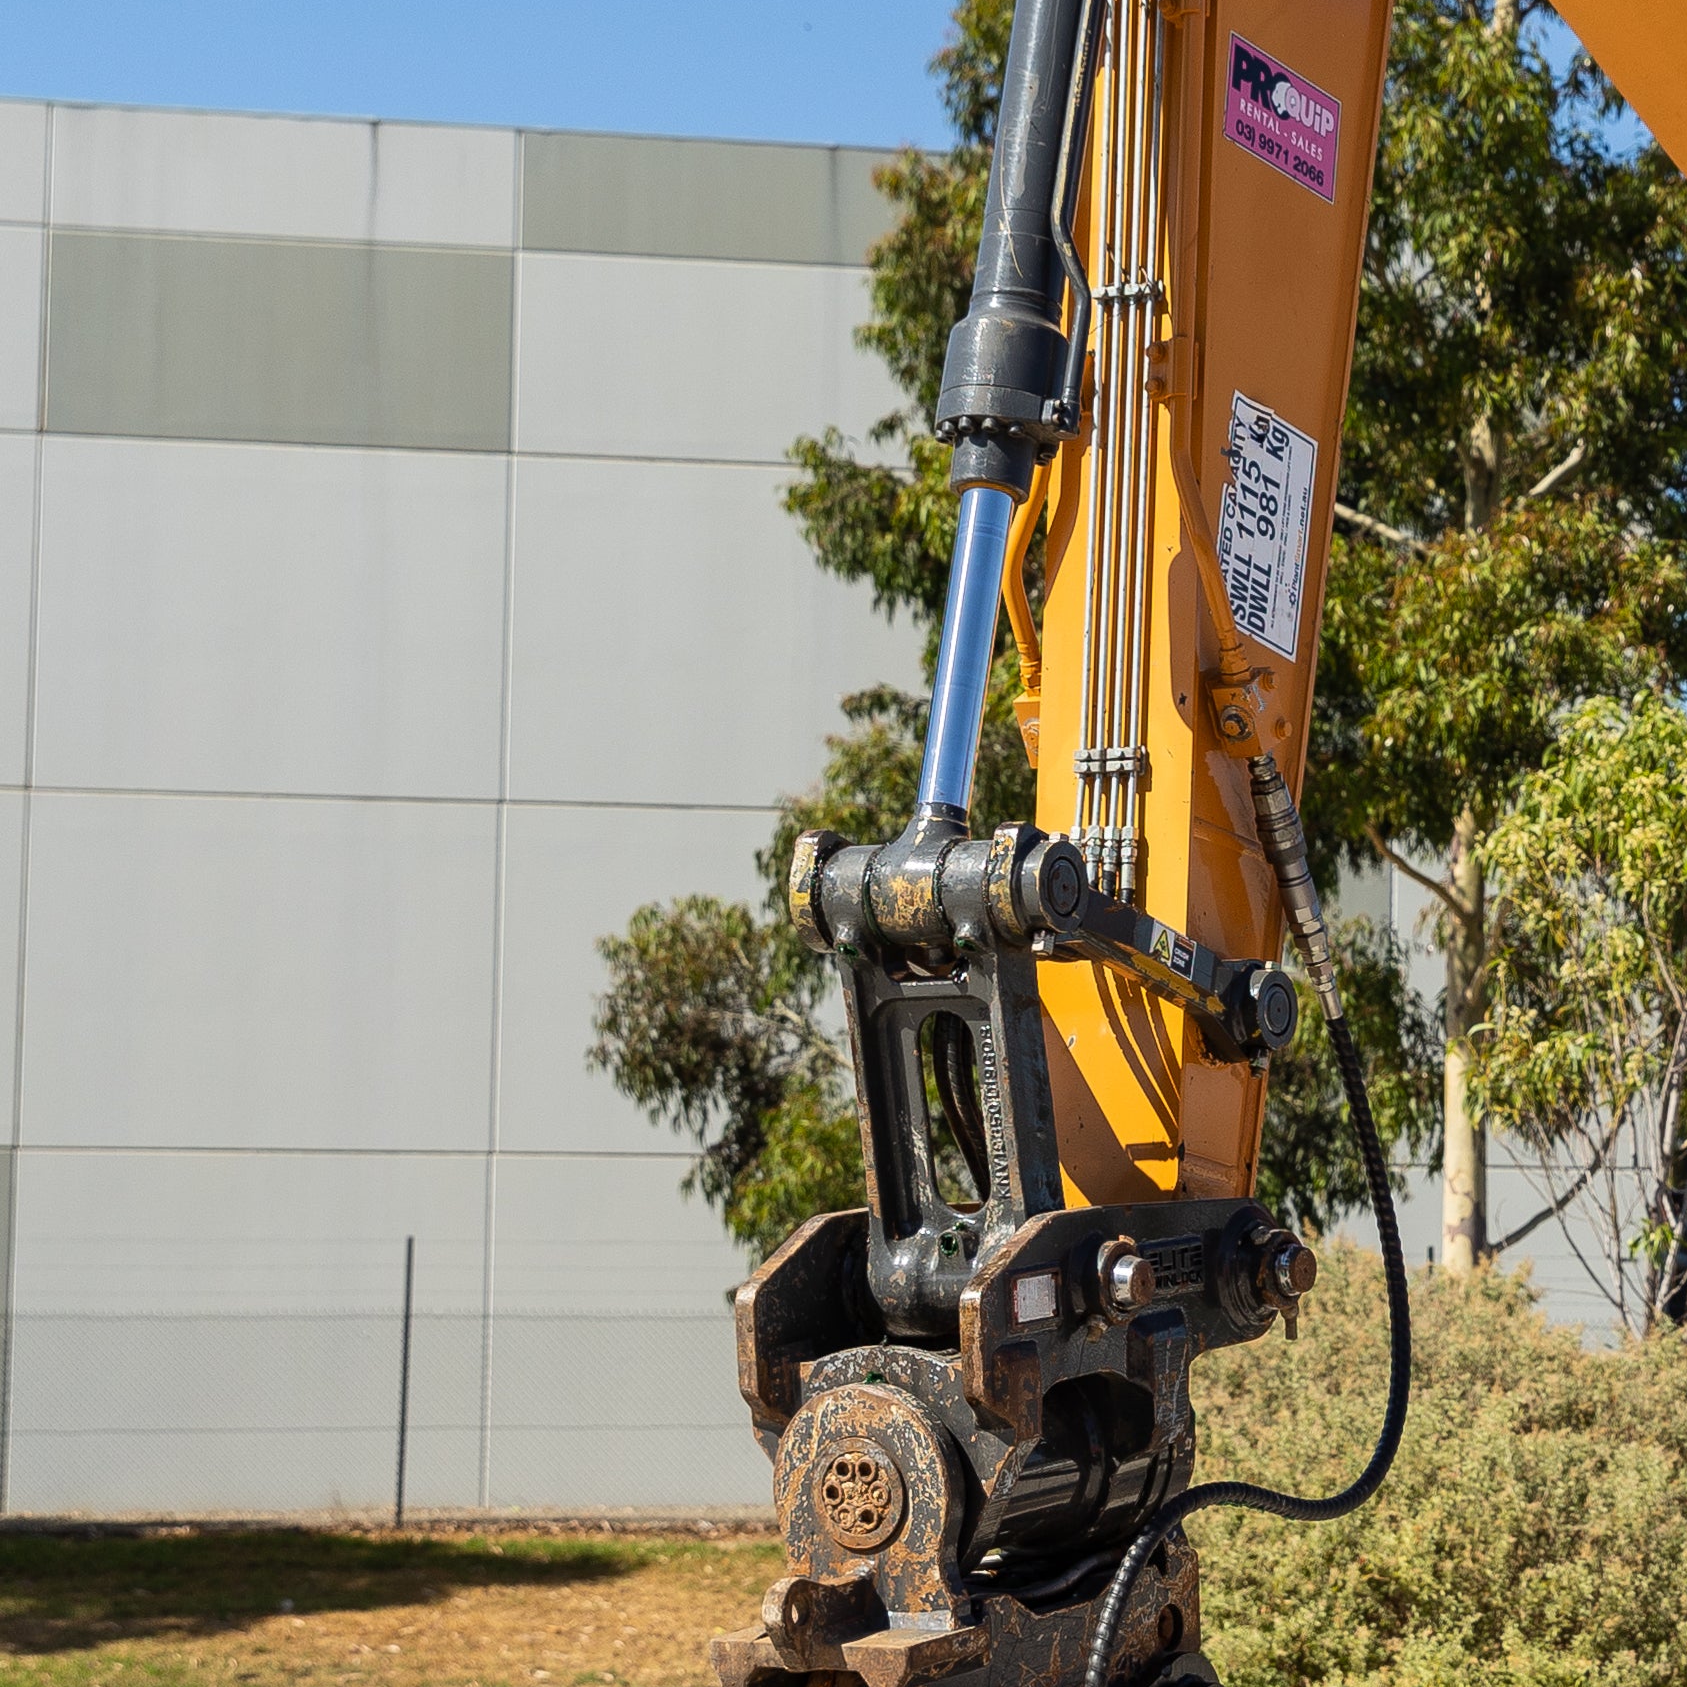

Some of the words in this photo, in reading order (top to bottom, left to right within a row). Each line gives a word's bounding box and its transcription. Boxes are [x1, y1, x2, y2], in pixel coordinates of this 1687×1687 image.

[1235, 118, 1255, 147] 03)
[1258, 134, 1289, 165] 9971
[1293, 155, 1324, 186] 2066
[1239, 98, 1281, 136] RENTAL
[1291, 130, 1324, 162] SALES
[1224, 415, 1247, 519] CAACITY
[1265, 425, 1290, 462] Kg
[1237, 457, 1263, 541] 1115
[1256, 473, 1281, 541] 981
[1220, 526, 1235, 585] ATED
[1229, 553, 1253, 621] SWLL
[1247, 563, 1273, 635] DWLL
